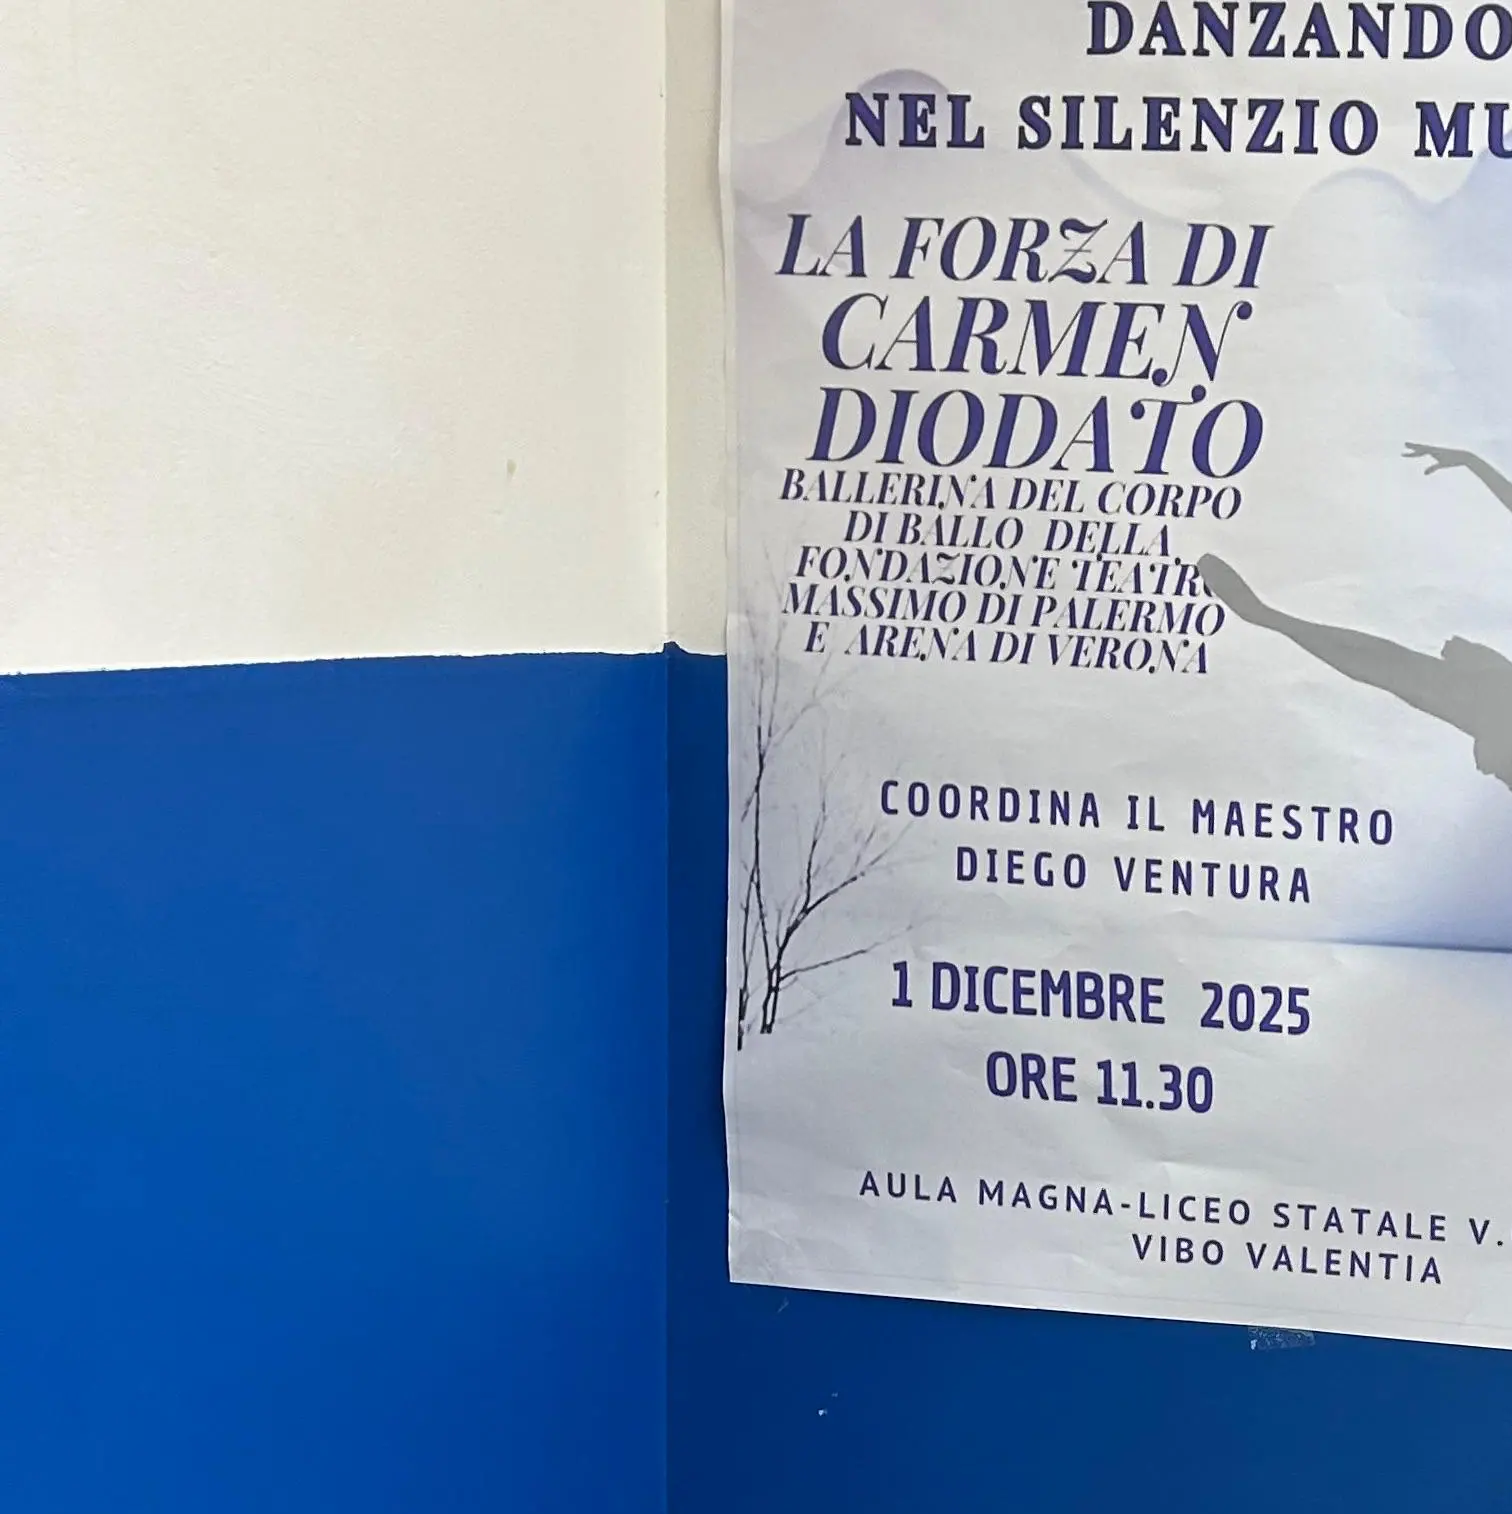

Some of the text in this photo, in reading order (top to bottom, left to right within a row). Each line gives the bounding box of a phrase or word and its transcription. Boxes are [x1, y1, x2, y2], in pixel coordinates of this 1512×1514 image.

[845, 92, 985, 149] NEL
[1018, 95, 1379, 157] SILENZIO
[775, 213, 1275, 289] LA FORZA DI
[822, 293, 1253, 388] CARMEN
[806, 384, 1264, 479] DIODATO
[780, 468, 1242, 520] BALLERINA DEL CORPO
[843, 508, 1171, 561] DI BALLO DELLA
[795, 545, 1214, 599] FONDAZIONE TEATR
[781, 582, 1226, 637] MASSIMO DI PALERMO
[804, 621, 1209, 675] E ARENA DI VERONA
[881, 780, 1394, 846] COORDINA IL MAESTRO
[956, 846, 1311, 904] DIEGO VENTURA
[891, 961, 1311, 1036] 1 DICEMBRE 2025
[986, 1051, 1214, 1114] ORE 11.30
[859, 1170, 958, 1204] AULA
[1272, 1202, 1448, 1243] STATALE
[1132, 1234, 1443, 1286] VIBO VALENTIA
